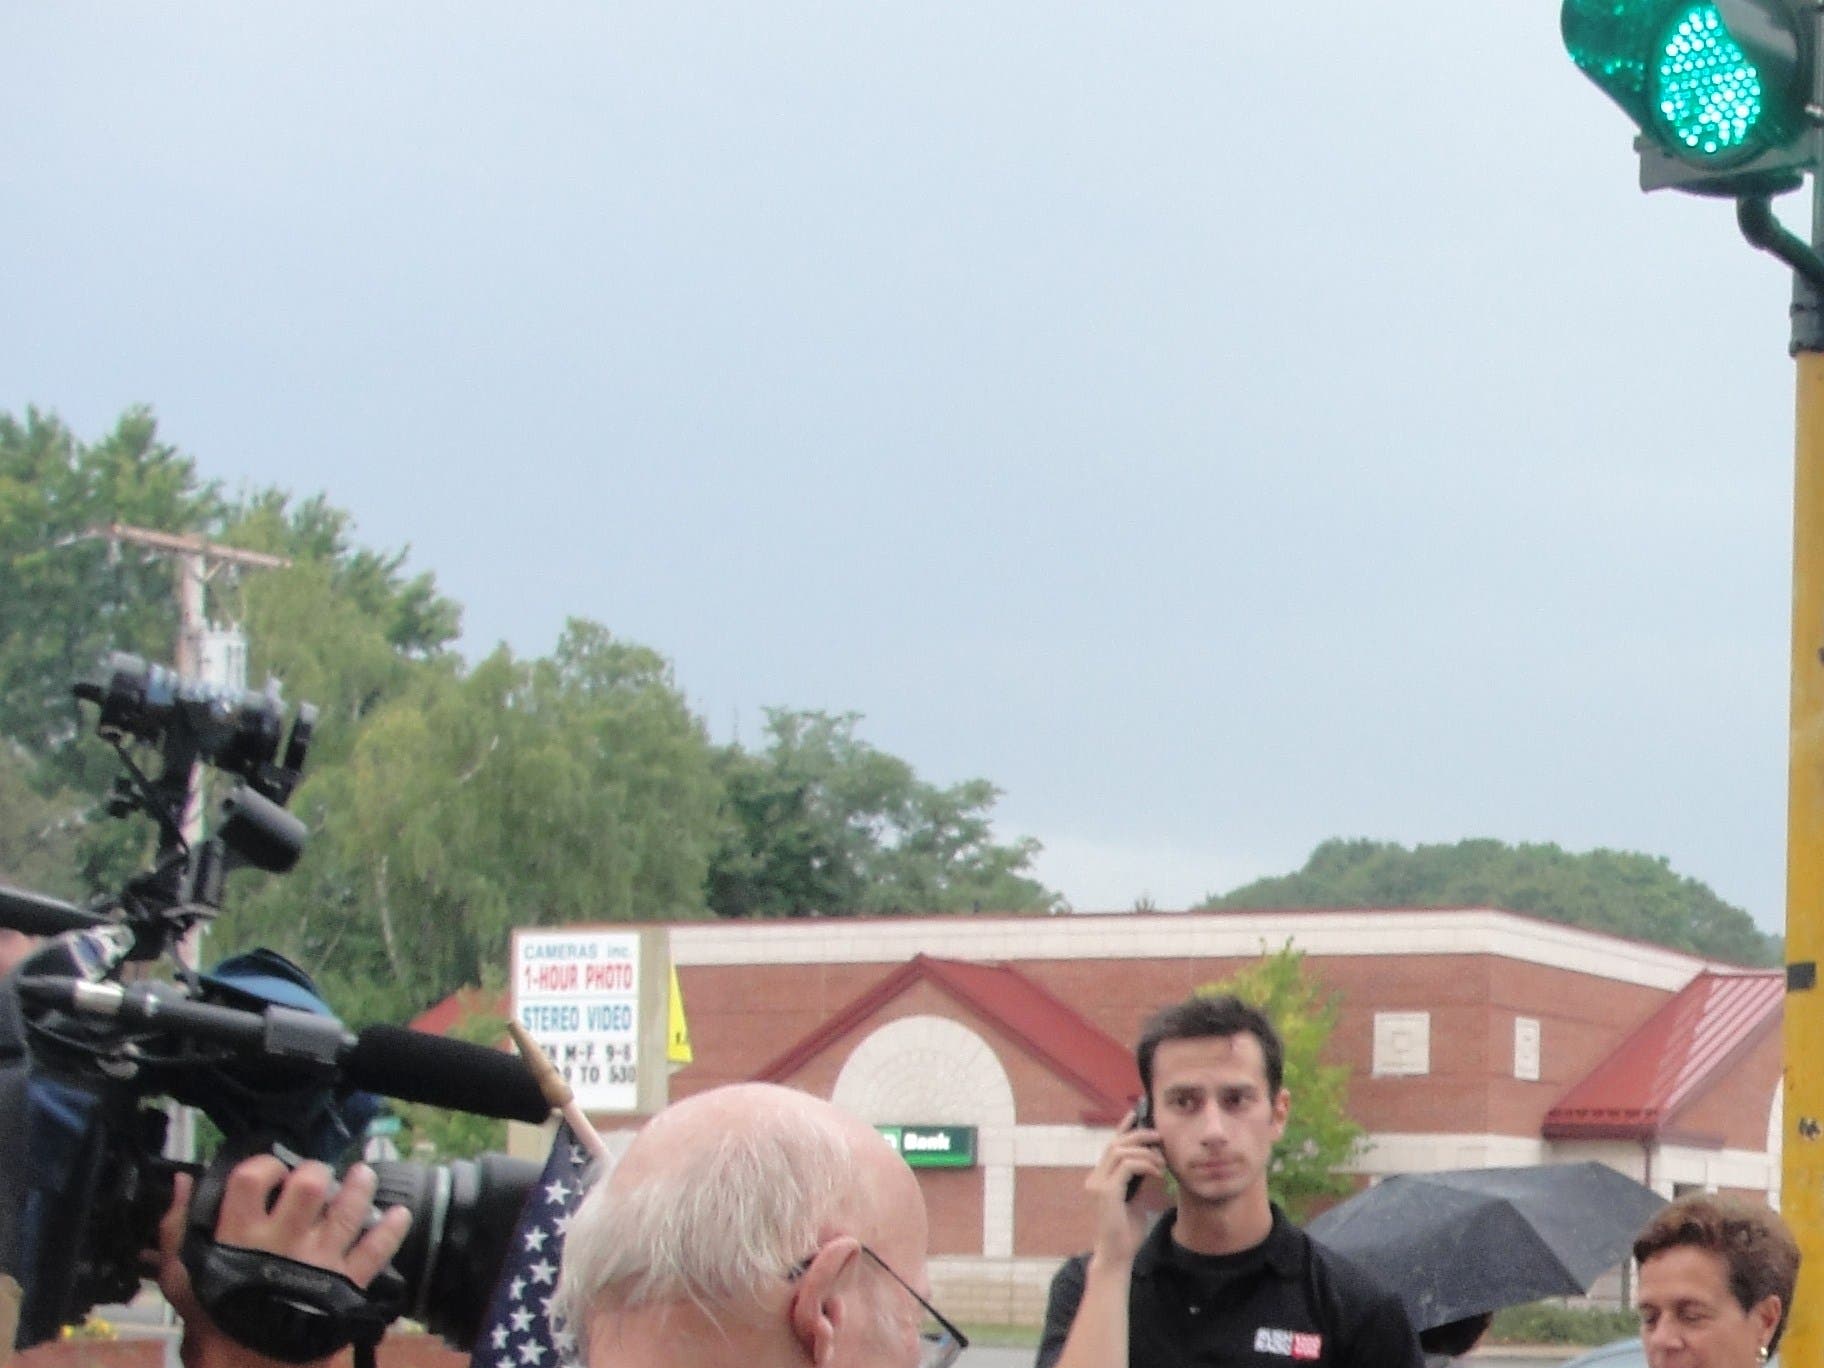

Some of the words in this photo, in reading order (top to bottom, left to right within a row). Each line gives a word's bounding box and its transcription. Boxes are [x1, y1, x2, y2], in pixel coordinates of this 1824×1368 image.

[524, 943, 597, 959] CAMERAS
[525, 964, 578, 990] 1-HOUR
[585, 963, 633, 990] PHOTO
[523, 1006, 579, 1031] STEREO
[587, 1005, 632, 1031] VIDEO
[581, 1066, 600, 1083] TO
